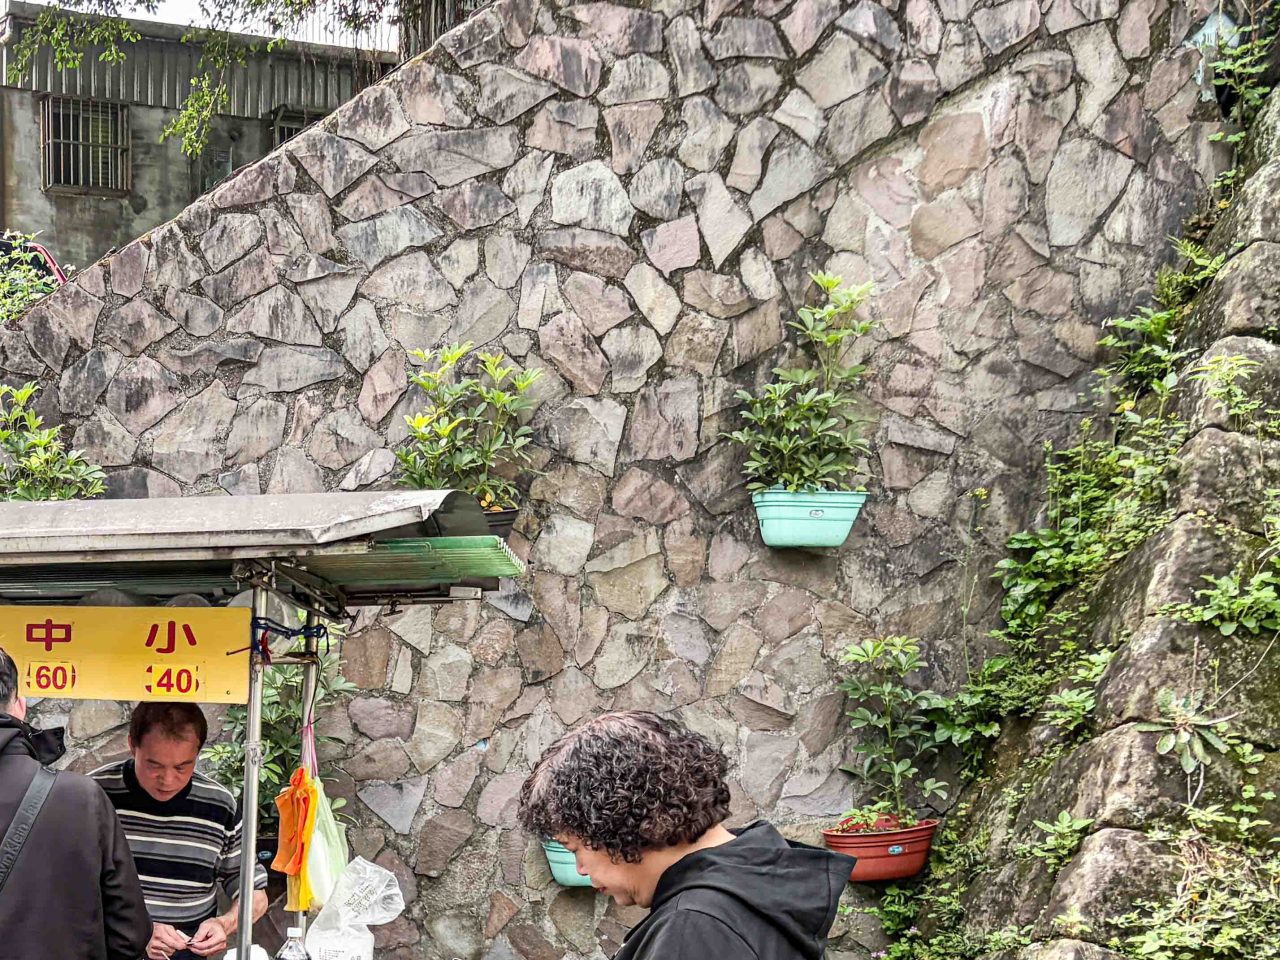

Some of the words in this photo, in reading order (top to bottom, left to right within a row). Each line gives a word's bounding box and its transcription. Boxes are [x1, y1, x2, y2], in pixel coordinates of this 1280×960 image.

[26, 618, 72, 652] 中
[145, 620, 197, 654] 小
[35, 665, 68, 690] 60
[156, 668, 193, 694] 40
